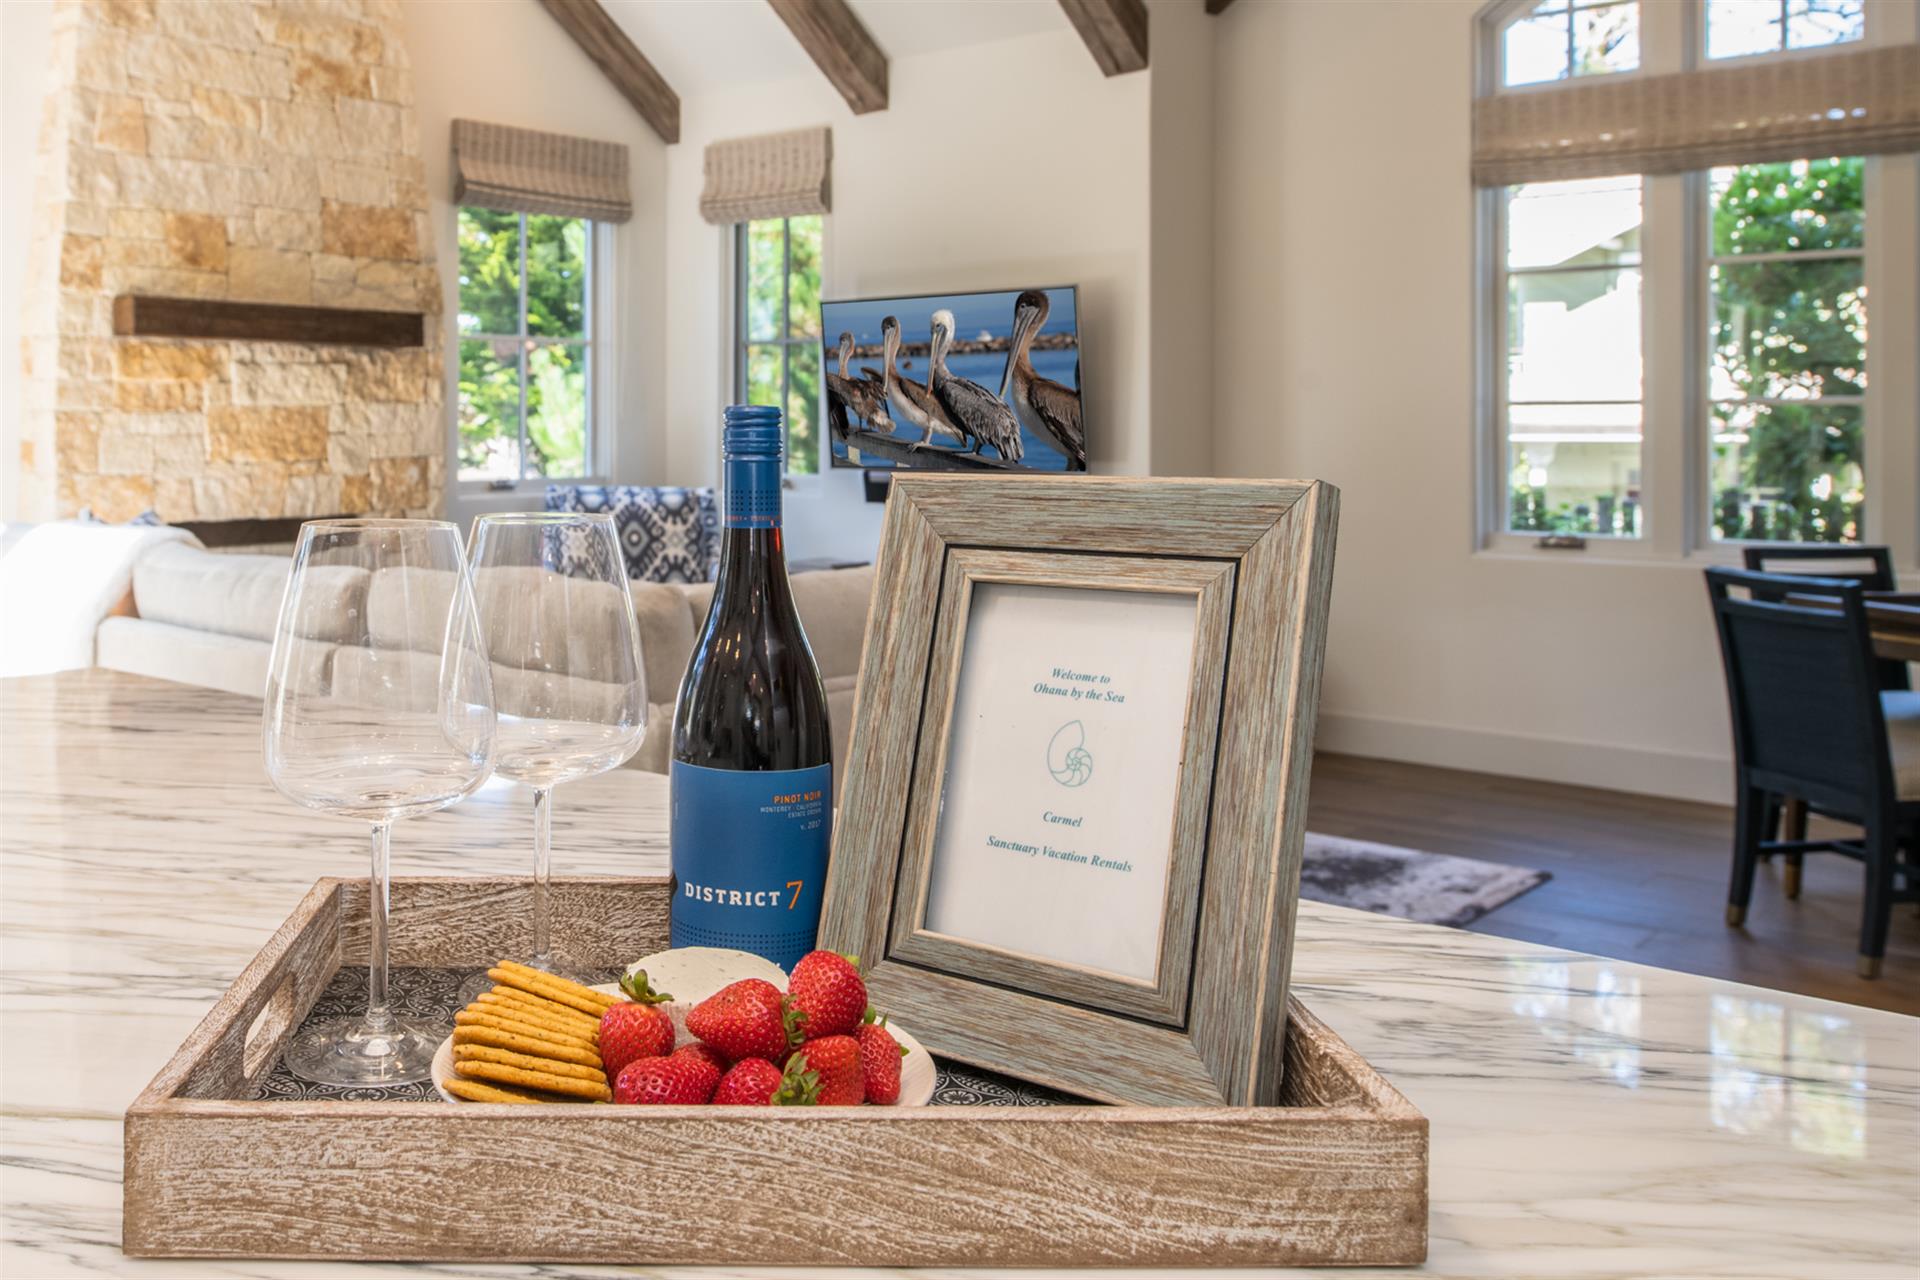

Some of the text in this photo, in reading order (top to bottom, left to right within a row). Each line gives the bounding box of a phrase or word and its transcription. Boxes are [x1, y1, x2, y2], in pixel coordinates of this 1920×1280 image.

[1052, 668, 1111, 684] Welcome to
[1033, 682, 1125, 703] Ohana by the Sea
[773, 790, 822, 804] PINOT NOIR
[1042, 811, 1084, 827] Carmel
[986, 835, 1133, 872] Sanctuary Vacation Rentals
[685, 880, 804, 910] DISTRICT 7
